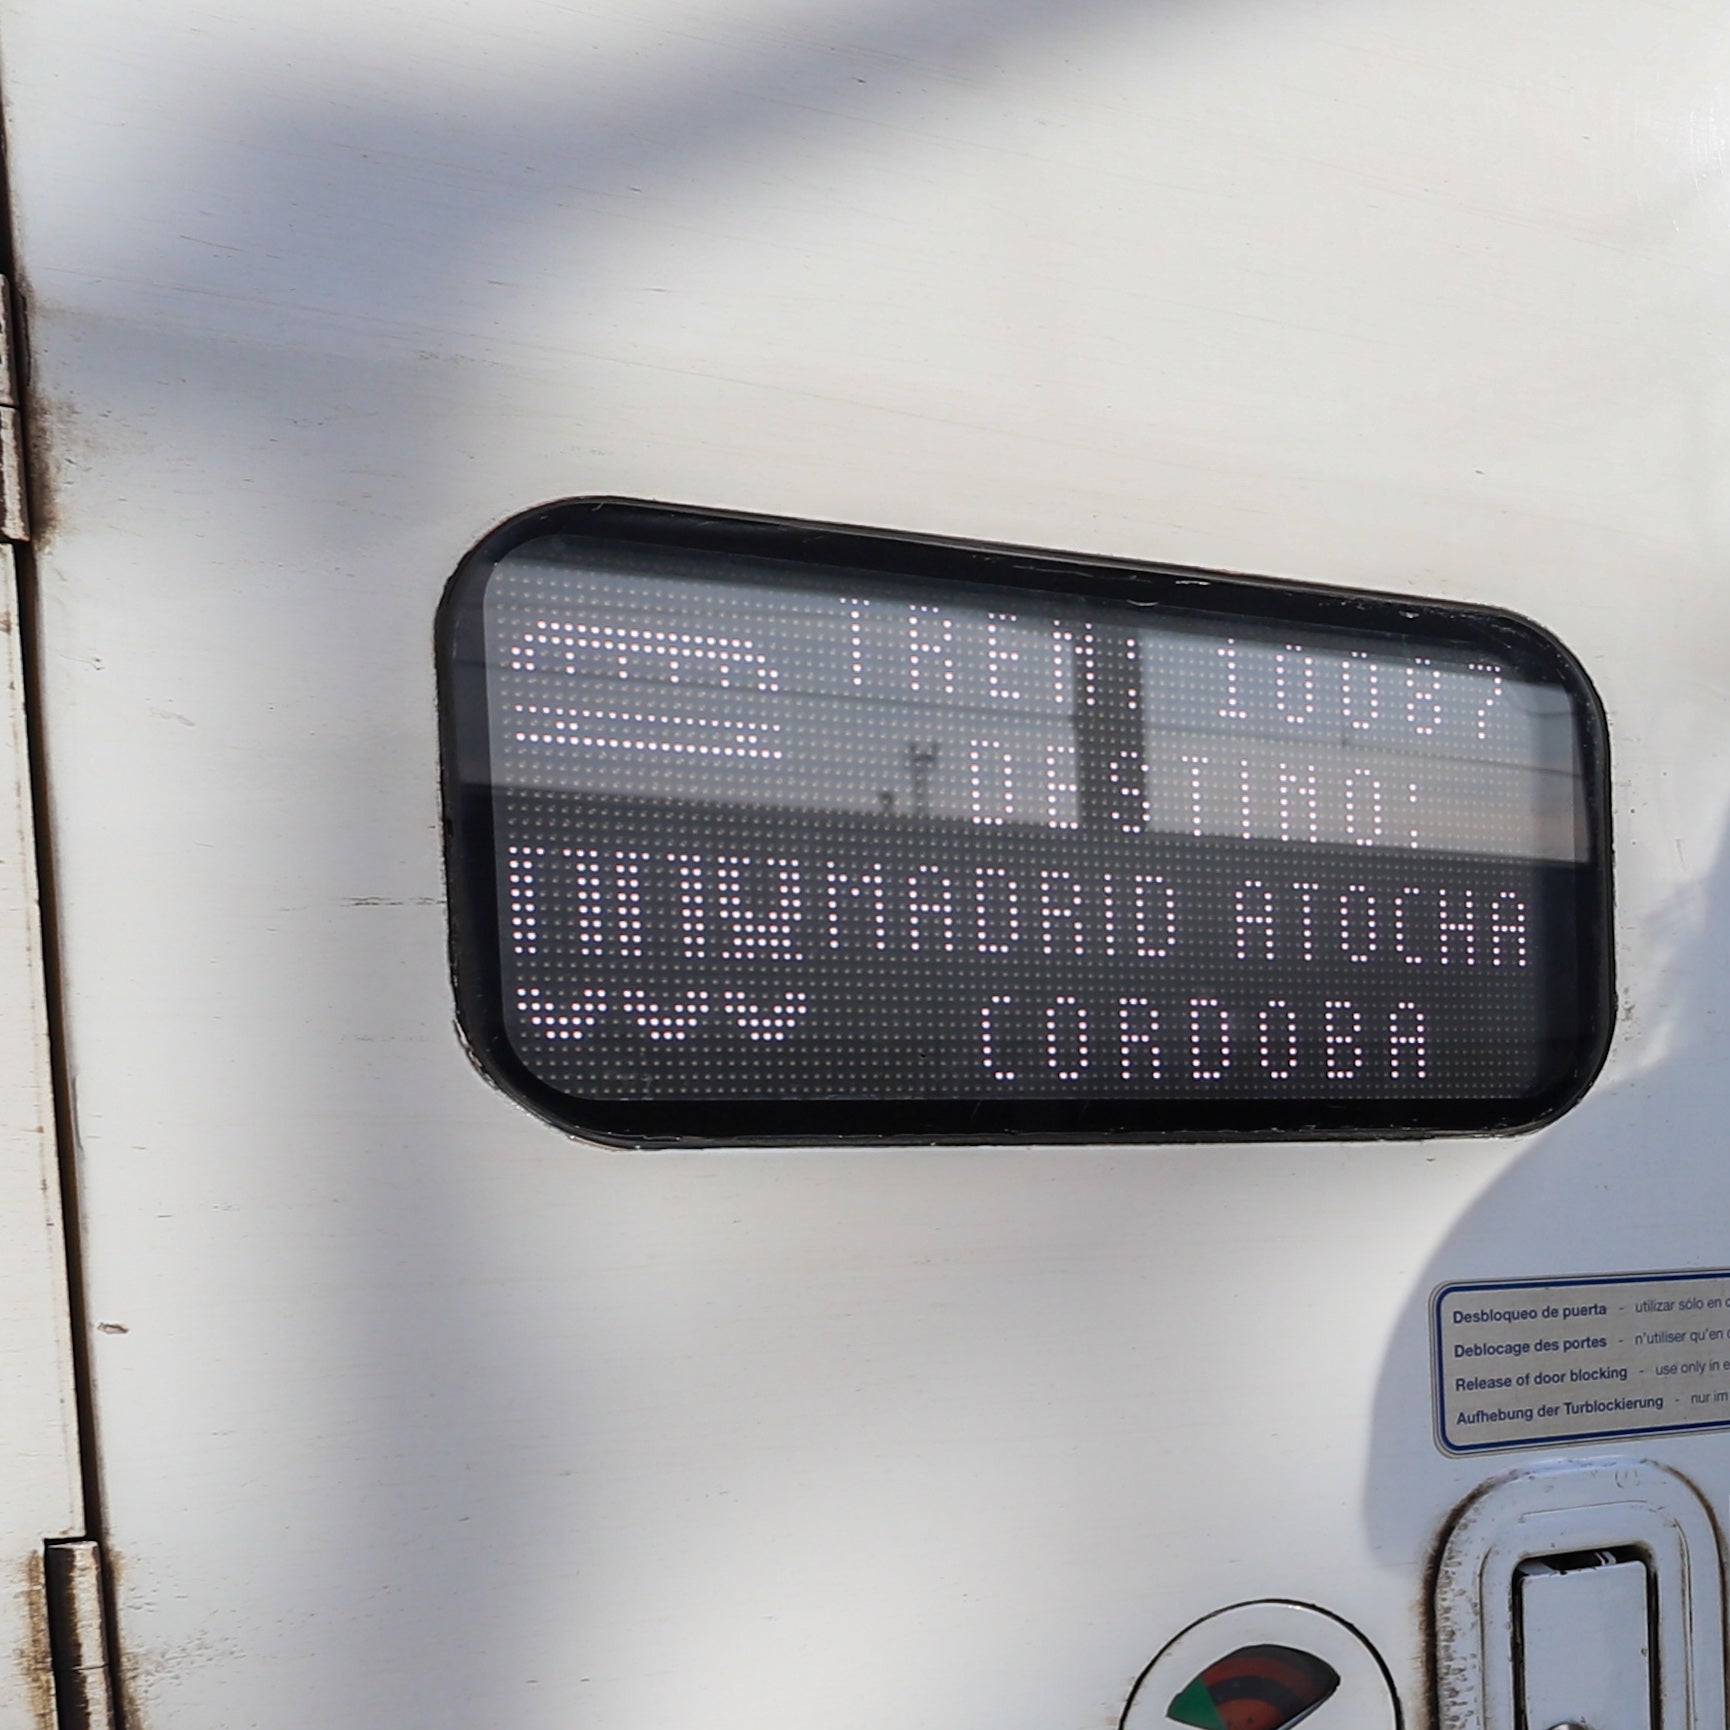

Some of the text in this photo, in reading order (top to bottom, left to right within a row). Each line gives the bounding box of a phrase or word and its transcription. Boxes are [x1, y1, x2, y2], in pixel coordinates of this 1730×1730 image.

[839, 597, 1502, 740] TREN: 10087
[969, 739, 1418, 849] DESTINO:
[826, 859, 1527, 968] MADRID ATOCHA
[981, 994, 1427, 1080] CORDOBA
[1453, 1308, 1538, 1324] Desbloqueo
[1541, 1306, 1559, 1319] de
[1563, 1303, 1607, 1320] puerta
[1635, 1299, 1675, 1313] utilizar
[1678, 1296, 1704, 1311] sólo
[1707, 1298, 1722, 1309] en
[1454, 1341, 1530, 1358] Deblocage
[1534, 1338, 1559, 1352] des
[1563, 1336, 1607, 1353] portes
[1455, 1376, 1512, 1392] Release
[1516, 1373, 1530, 1386] of
[1534, 1371, 1566, 1385] door
[1570, 1366, 1628, 1383] blocking
[1655, 1363, 1678, 1376] use
[1681, 1358, 1706, 1375] only
[1709, 1358, 1720, 1371] in
[1456, 1408, 1533, 1425] Aufhebung
[1537, 1404, 1560, 1418] der
[1563, 1396, 1664, 1415] Turblockierung
[1691, 1392, 1710, 1404] nur
[1713, 1388, 1728, 1402] im
